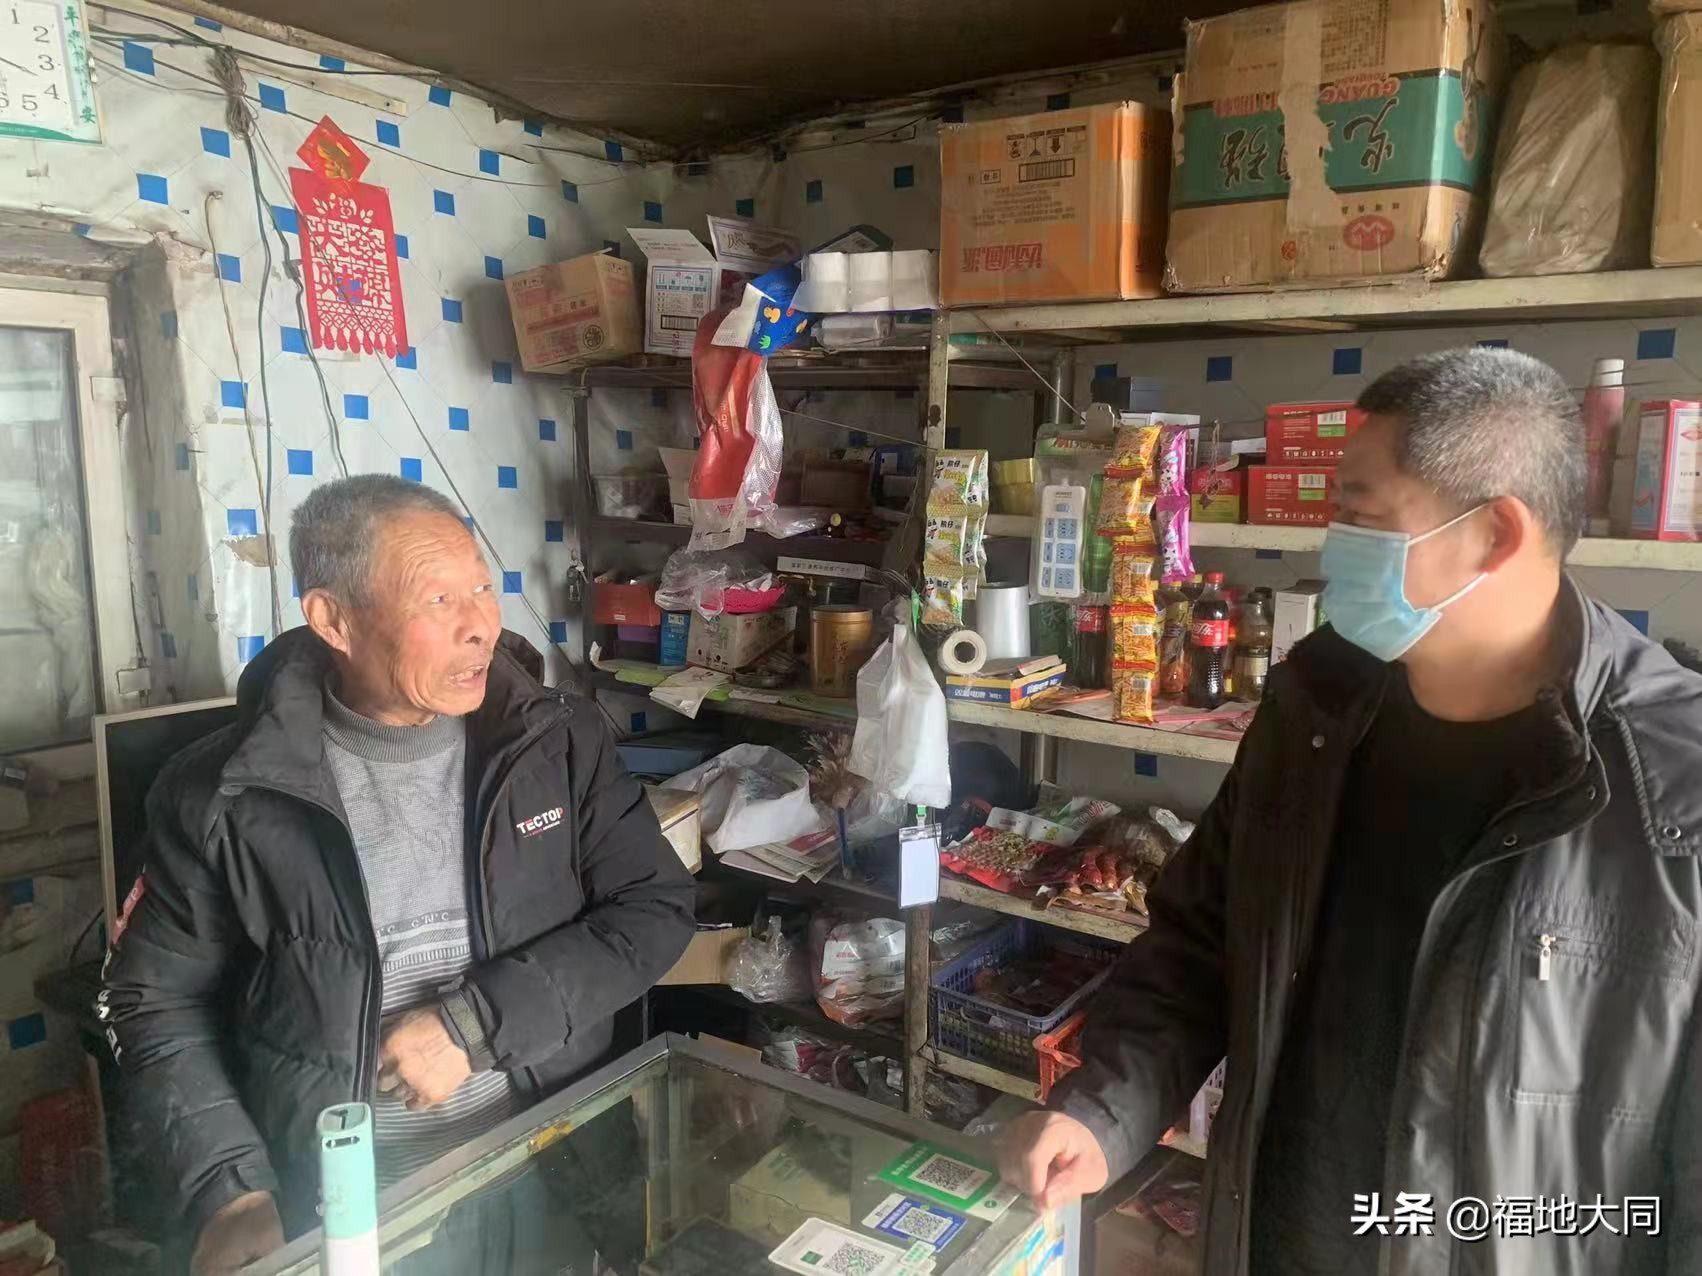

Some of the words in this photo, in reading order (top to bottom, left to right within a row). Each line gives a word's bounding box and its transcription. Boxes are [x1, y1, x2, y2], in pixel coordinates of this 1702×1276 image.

[11, 8, 21, 25] 1
[33, 25, 51, 44] 2
[38, 54, 55, 71] 3
[44, 83, 60, 100] 4
[22, 94, 38, 111] 5
[516, 807, 564, 834] TECTOP
